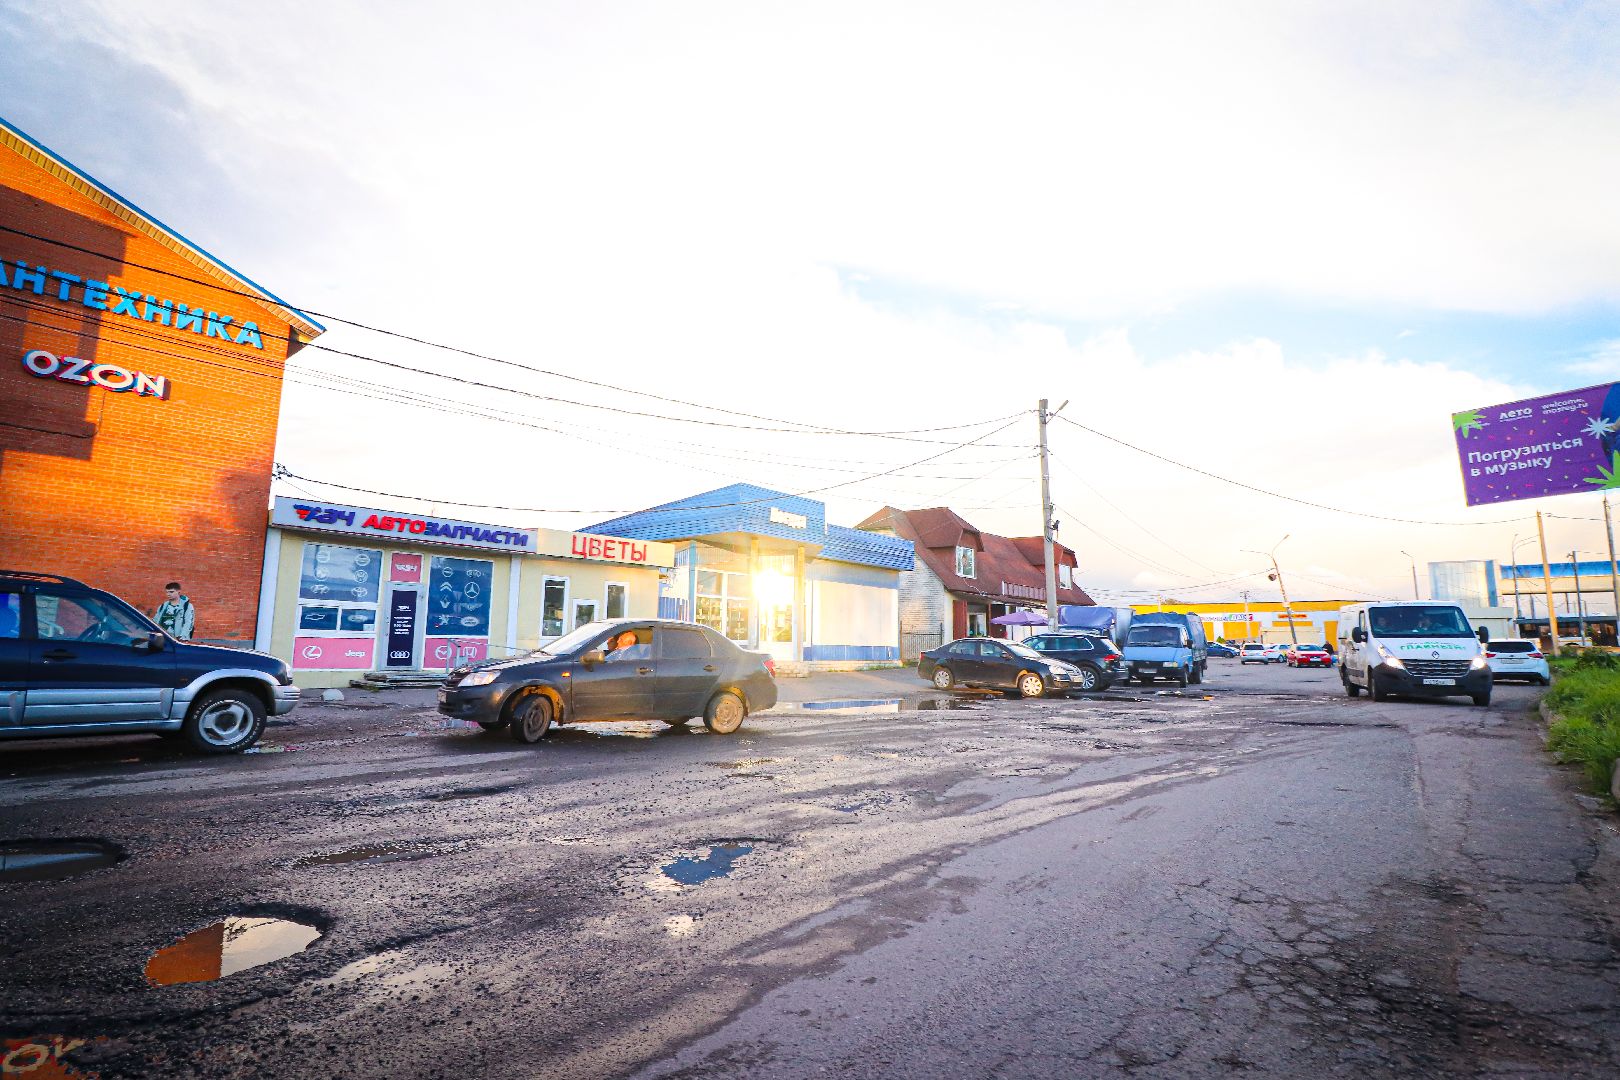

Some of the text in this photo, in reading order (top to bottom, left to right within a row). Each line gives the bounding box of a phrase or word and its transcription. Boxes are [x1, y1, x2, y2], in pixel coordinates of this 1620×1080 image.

[0, 256, 263, 348] НТЕХНИКА
[23, 351, 166, 400] OZON
[1468, 437, 1583, 463] Погрузиться
[1470, 456, 1552, 477] в музыку
[362, 514, 529, 546] АВТОЗАПЧАСТИ
[572, 535, 648, 562] ЦВЕТЫ
[345, 649, 366, 658] Jeep
